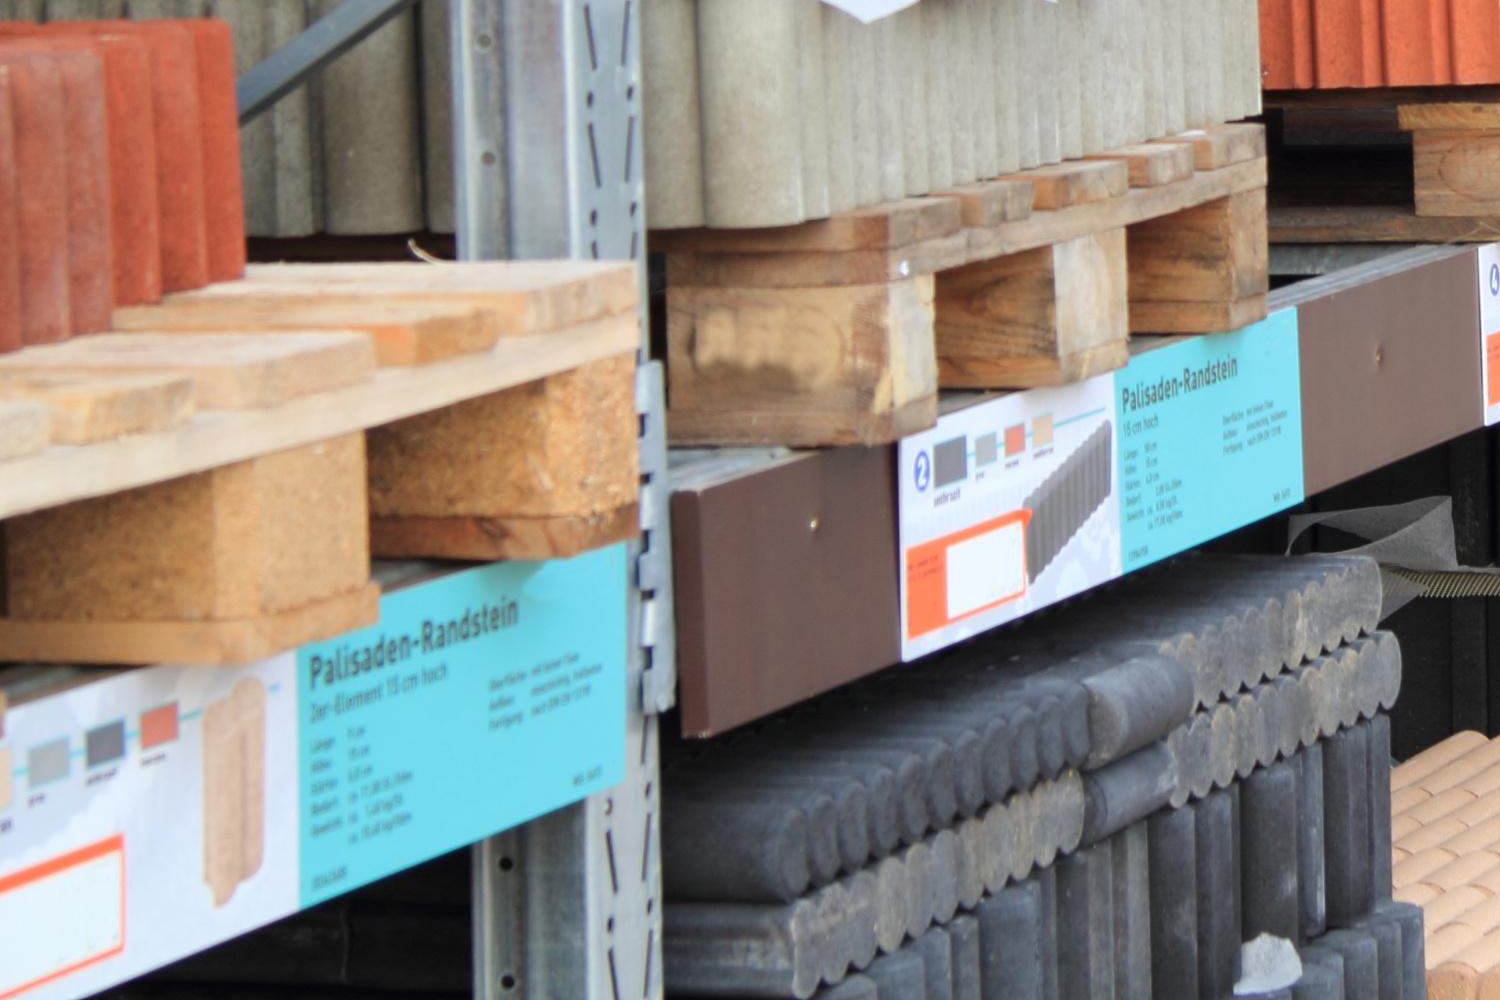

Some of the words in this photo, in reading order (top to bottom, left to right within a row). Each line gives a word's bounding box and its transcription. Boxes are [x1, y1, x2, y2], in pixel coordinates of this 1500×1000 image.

[1122, 353, 1238, 414] Palisaden-Randstein
[1123, 420, 1131, 439] 15
[1132, 420, 1142, 436] cm
[1143, 413, 1159, 431] hoch
[310, 596, 519, 690] Palisaden-Randstein
[310, 685, 384, 724] 2er-Element
[402, 671, 418, 692] cm
[422, 661, 447, 686] hoch
